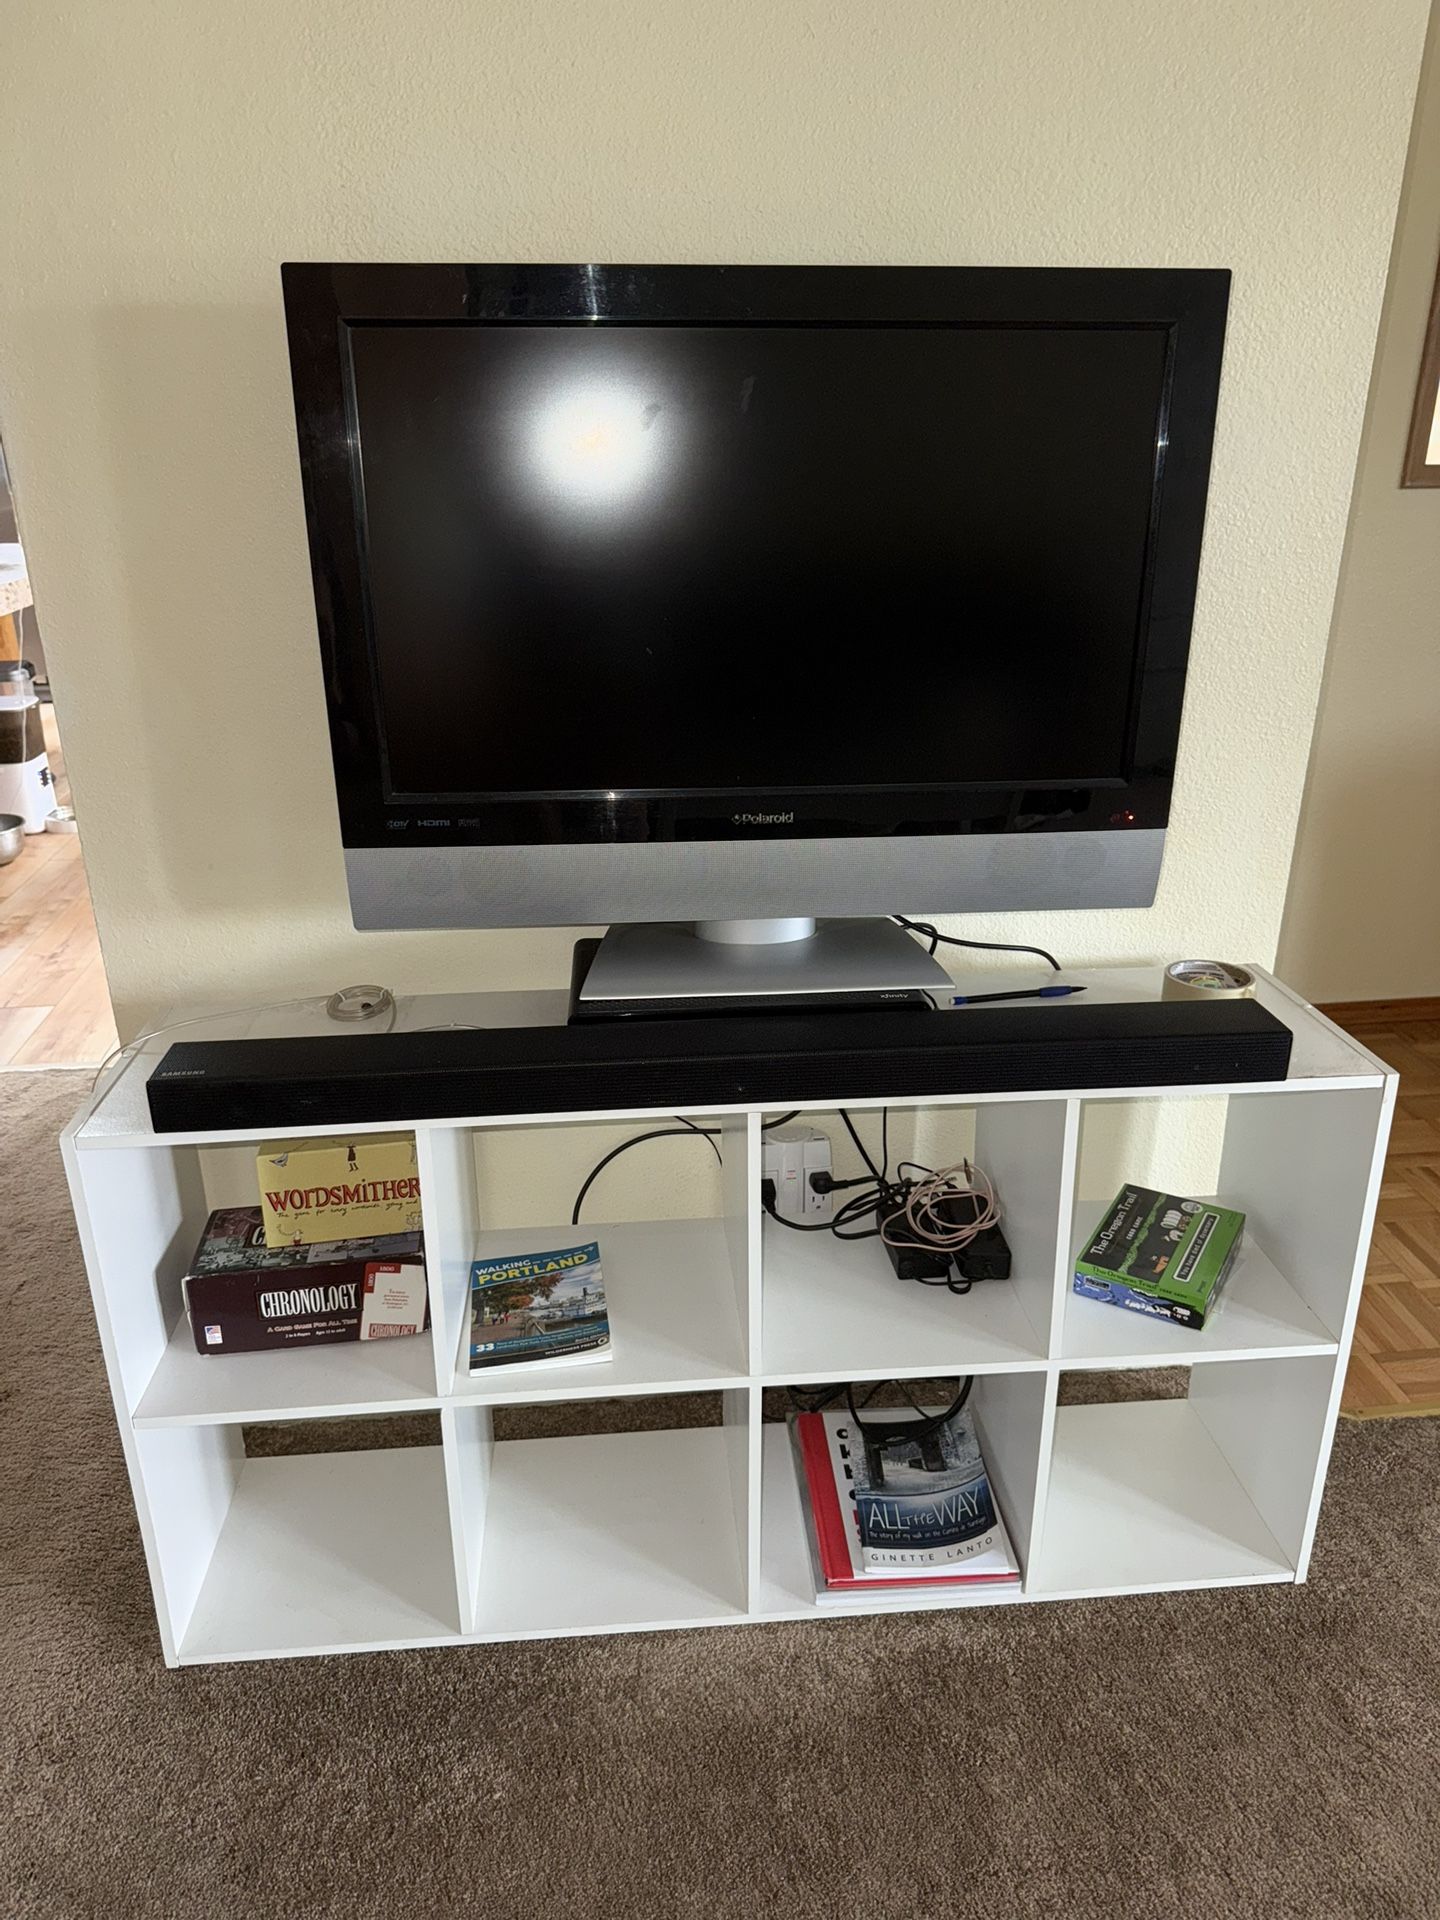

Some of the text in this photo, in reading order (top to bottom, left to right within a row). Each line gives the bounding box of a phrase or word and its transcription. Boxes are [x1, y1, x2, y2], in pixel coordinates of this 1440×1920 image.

[742, 812, 794, 825] Polaroid
[1090, 1239, 1109, 1255] The
[1100, 1211, 1127, 1240] Oregon
[1117, 1190, 1138, 1210] Trail
[476, 1259, 531, 1275] WALKING
[478, 1253, 588, 1285] PORTLAND
[1180, 1266, 1189, 1278] You
[260, 1283, 358, 1318] CHRONOLOGY
[370, 1324, 415, 1337] CHRONOLOGY
[476, 1343, 495, 1353] 33
[869, 1502, 911, 1530] ALL
[932, 1486, 979, 1526] WAY
[871, 1536, 993, 1562] GINETTE LANTO
